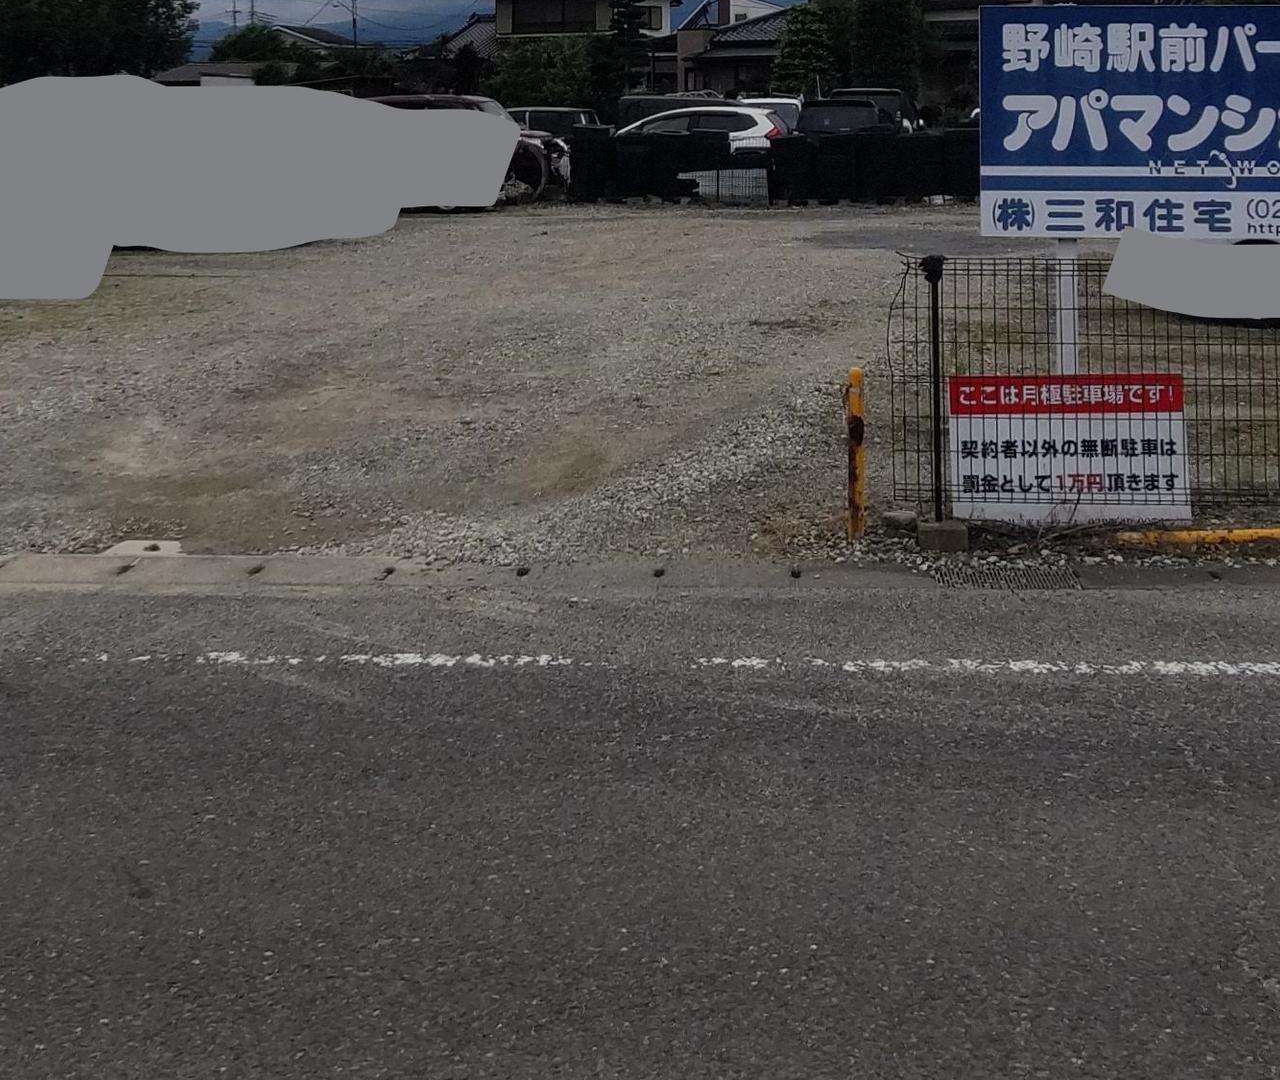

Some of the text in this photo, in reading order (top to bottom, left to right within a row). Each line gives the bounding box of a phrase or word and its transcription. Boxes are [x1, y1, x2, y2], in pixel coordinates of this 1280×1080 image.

[960, 438, 1177, 460] 契約者以外の無断駐車は
